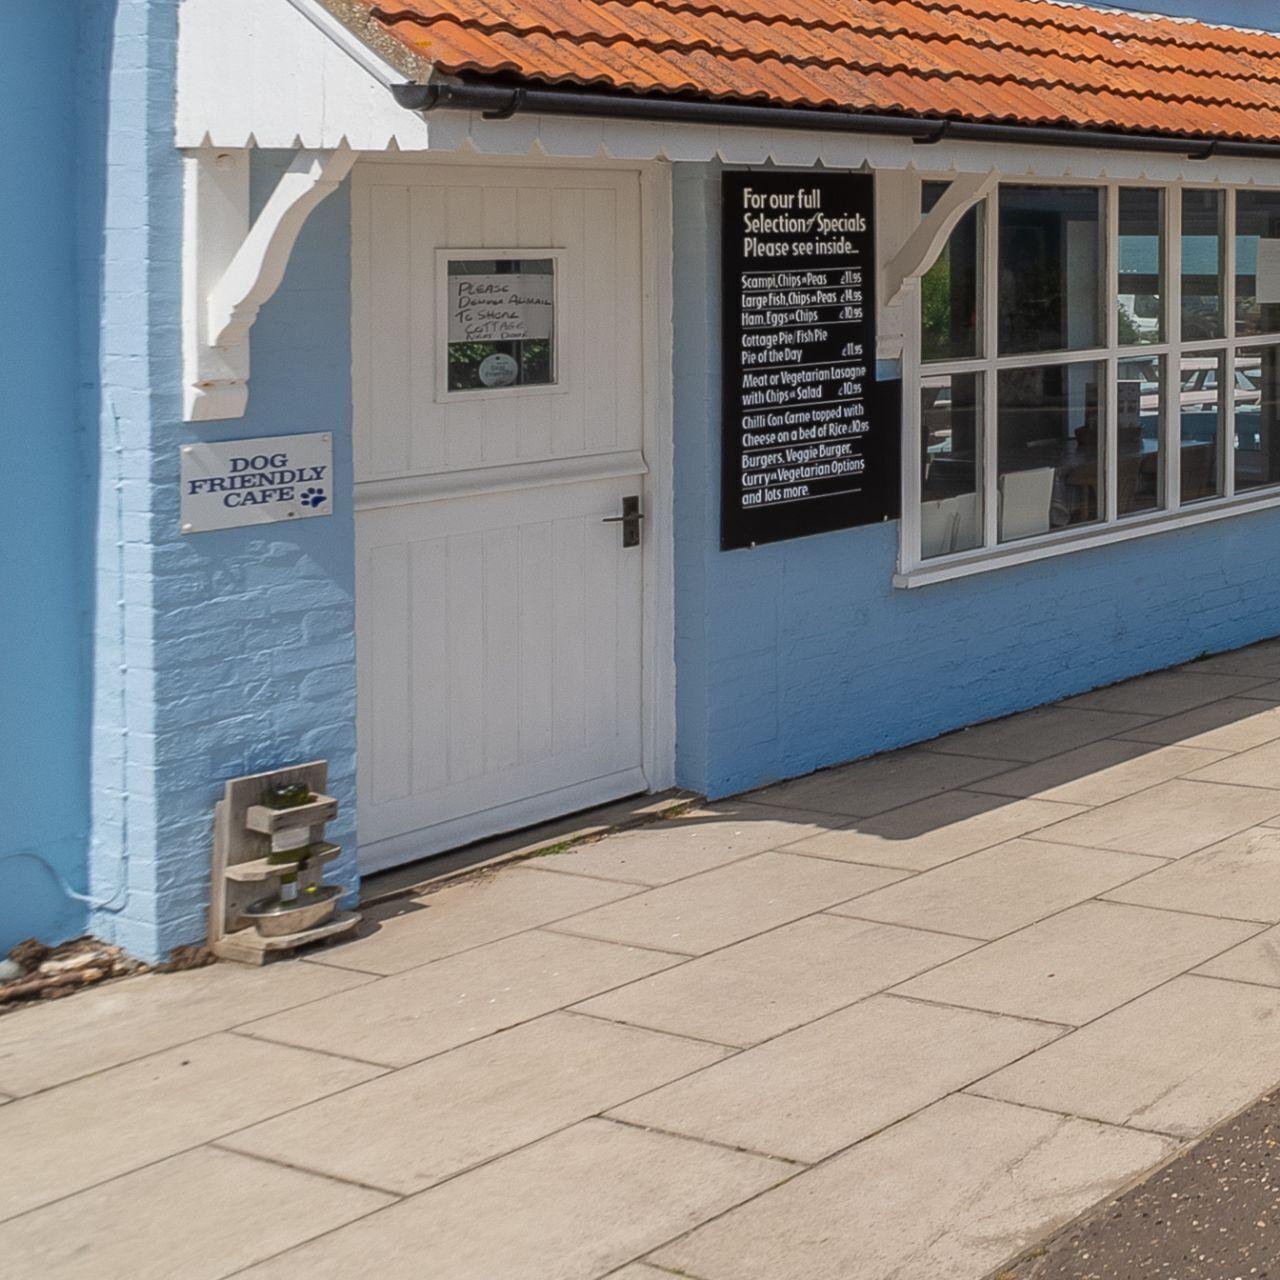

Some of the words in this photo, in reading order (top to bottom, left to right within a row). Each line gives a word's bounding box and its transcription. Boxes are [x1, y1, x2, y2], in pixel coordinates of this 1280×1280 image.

[743, 188, 766, 209] For
[769, 194, 794, 209] our
[798, 189, 820, 209] full
[743, 213, 804, 233] Selection
[817, 213, 866, 236] Specials
[743, 237, 789, 258] Please
[791, 242, 813, 256] see
[458, 282, 510, 297] PLEASE
[777, 273, 801, 288] Chips
[806, 272, 827, 286] Peas
[741, 294, 767, 310] Large
[787, 291, 810, 306] Chips
[816, 290, 837, 304] Peas
[766, 311, 788, 327] Eggs
[795, 309, 818, 323] Chips
[741, 334, 777, 350] Cottage
[814, 329, 828, 342] Pie
[741, 351, 756, 366] Pie
[757, 350, 768, 364] of
[768, 350, 783, 363] the
[784, 348, 802, 363] Day
[741, 374, 768, 389] Meat
[769, 374, 780, 386] or
[780, 367, 830, 387] Vegetarian
[831, 366, 866, 381] Lasagne
[741, 391, 765, 407] with
[765, 388, 789, 404] Chips
[796, 385, 822, 400] Salad
[741, 414, 765, 430] Chilli
[767, 413, 783, 427] Con
[784, 411, 811, 425] Carne
[811, 405, 842, 423] topped
[843, 403, 864, 418] with
[741, 432, 776, 448] Cheese
[777, 430, 790, 443] on
[790, 429, 798, 440] a
[798, 425, 816, 441] bed
[817, 424, 828, 438] of
[828, 423, 847, 437] Rice
[229, 453, 289, 473] DOG
[785, 446, 818, 464] Veggie
[187, 465, 328, 495] FRIENDLY
[741, 472, 770, 487] Curry
[777, 464, 830, 484] Vegetarian
[831, 459, 865, 476] Options
[223, 486, 296, 508] CAFE
[741, 489, 761, 506] and
[764, 487, 781, 502] lots
